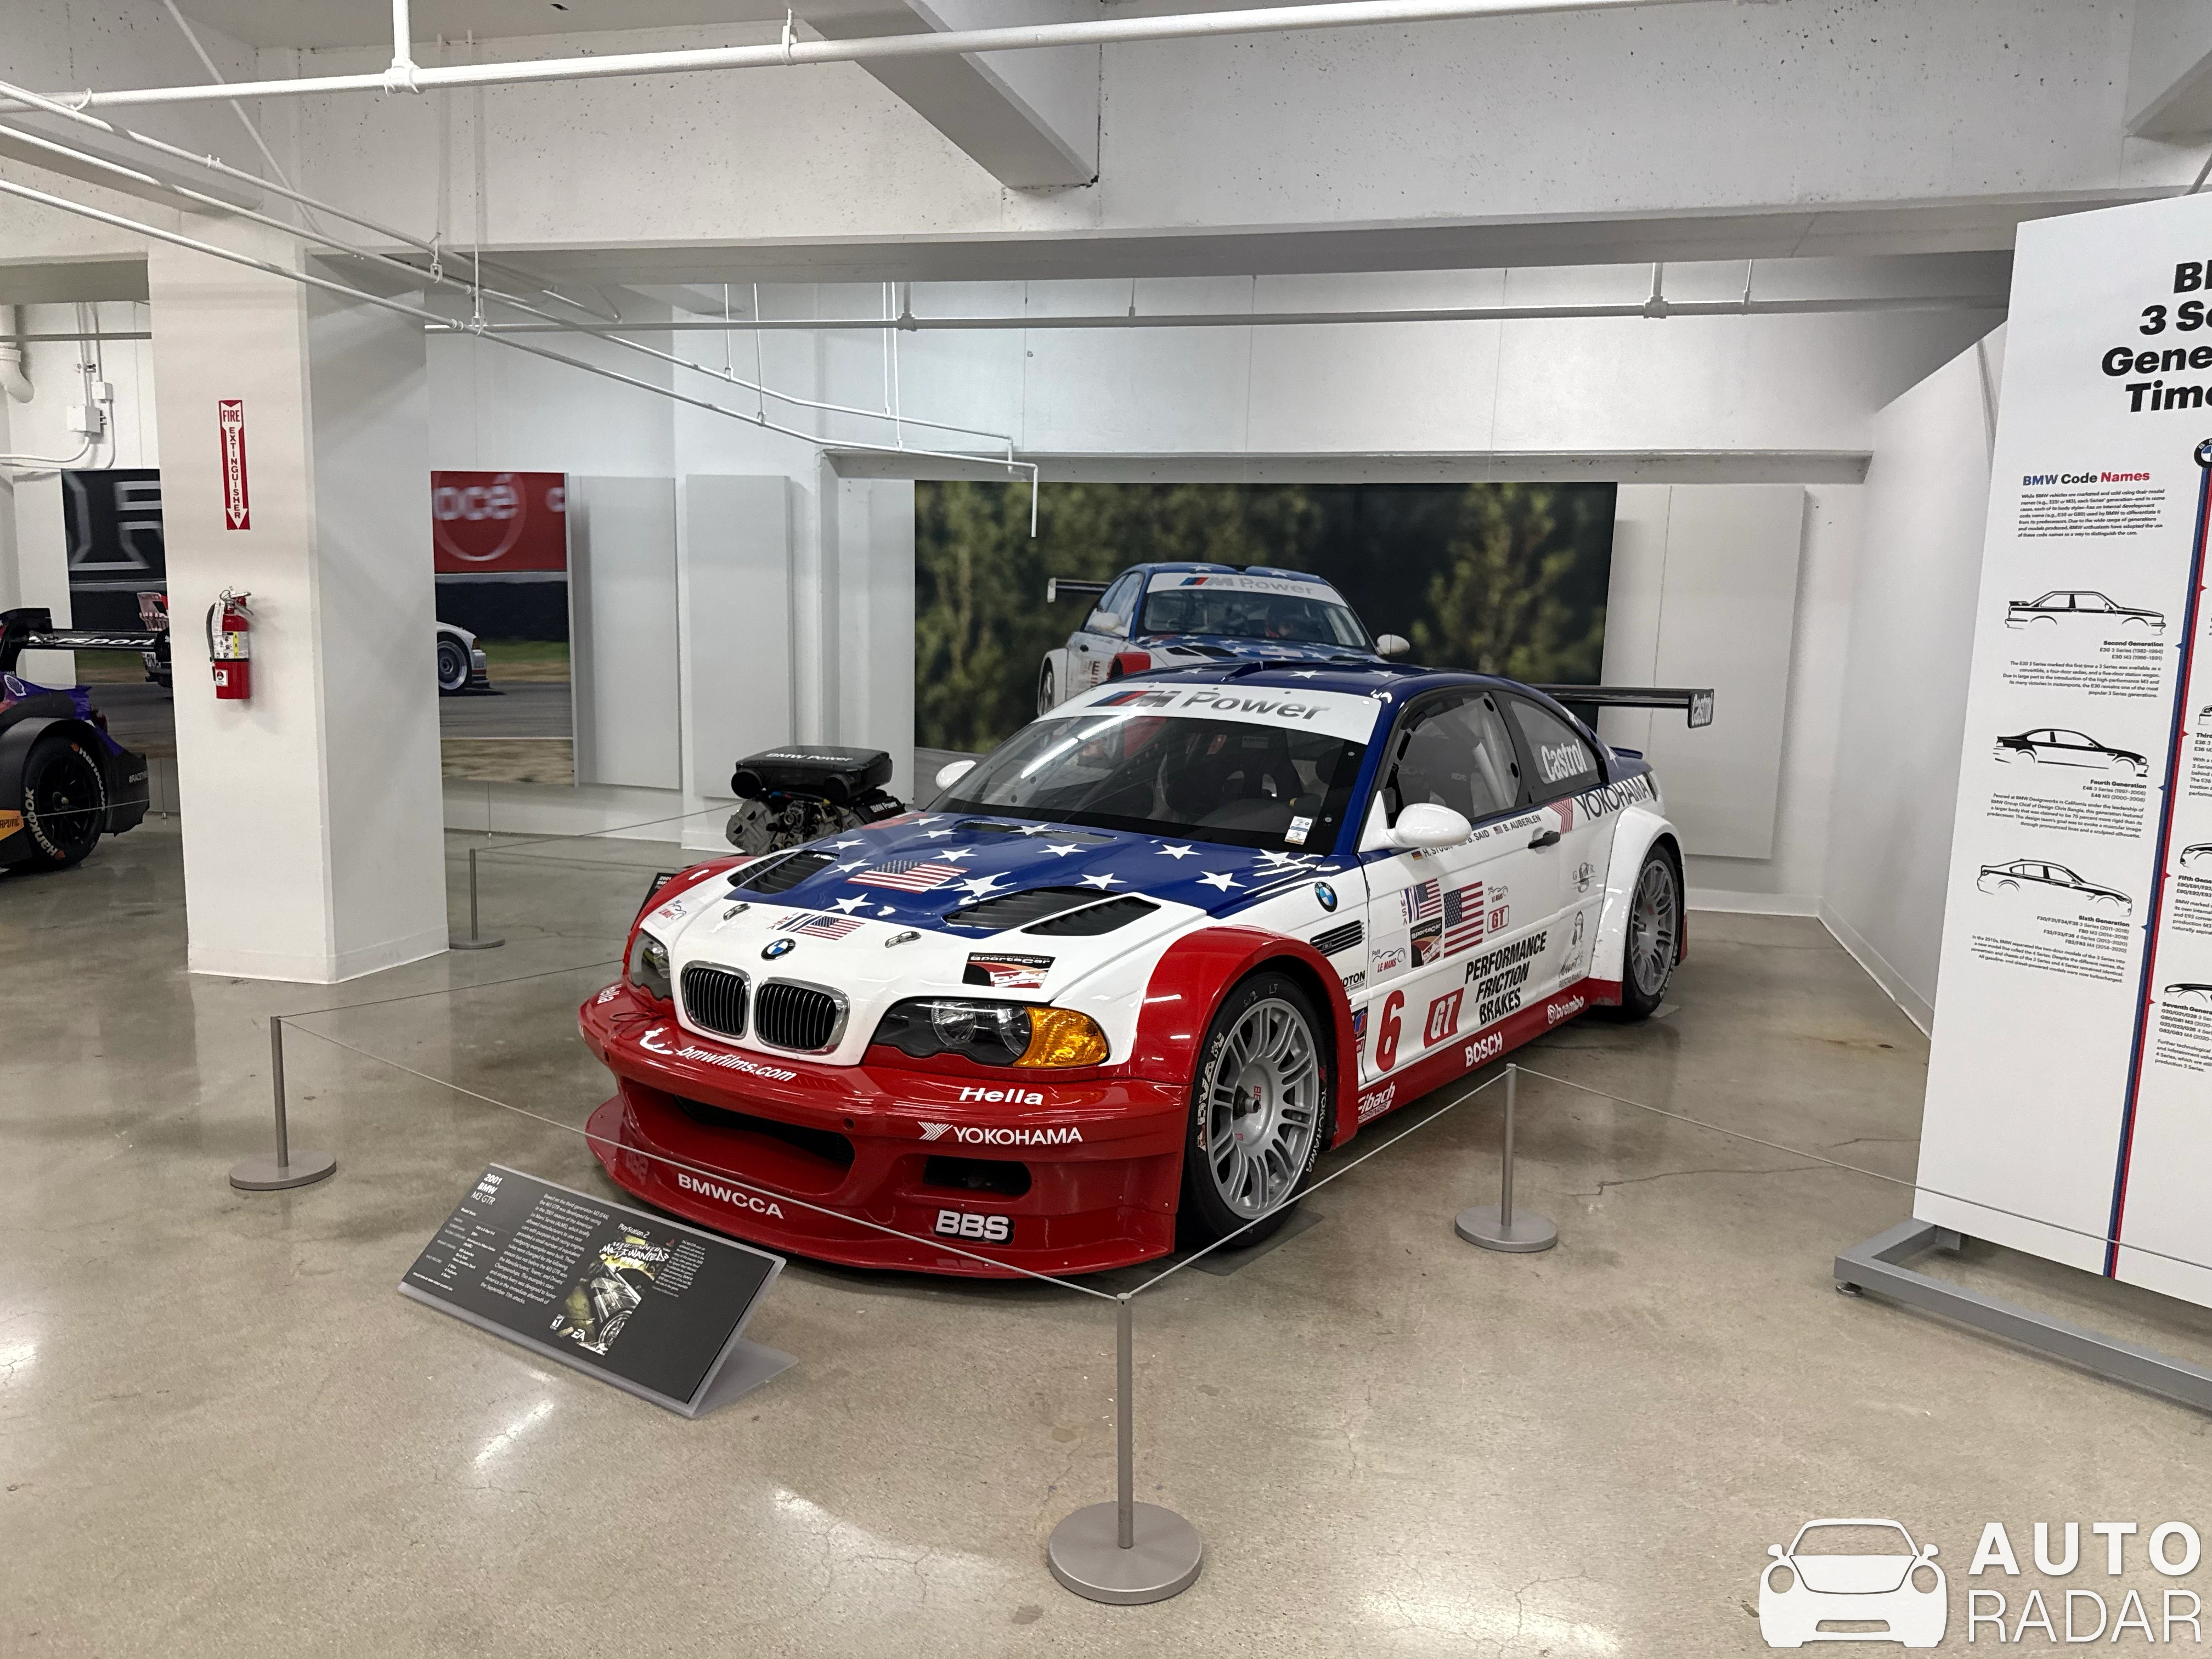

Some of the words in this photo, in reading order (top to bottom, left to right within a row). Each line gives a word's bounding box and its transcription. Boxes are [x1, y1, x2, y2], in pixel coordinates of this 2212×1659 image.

[2140, 305, 2166, 335] 3
[2176, 301, 2212, 331] S
[2102, 346, 2212, 376] Gene
[2125, 380, 2212, 413] Tim
[223, 410, 240, 422] FIRE
[229, 427, 241, 518] EXTINGUISHER
[2023, 475, 2058, 486] BMW
[2061, 473, 2098, 484] Code
[2101, 472, 2150, 482] Names
[1239, 578, 1314, 596] Power
[1180, 691, 1330, 720] Power
[766, 753, 806, 761] BMW
[808, 754, 854, 763] Power
[1541, 738, 1588, 781] Castrol
[1575, 776, 1651, 821] YOKOHAMA
[1511, 814, 1541, 830] AUBERLEN
[1475, 830, 1490, 842] SAID
[1423, 849, 1431, 857] H.
[1492, 909, 1504, 929] GT
[2095, 918, 2130, 927] Generation
[1378, 962, 1384, 973] LE
[1384, 958, 1397, 971] MANS
[1465, 931, 1547, 984] PERFORMANCE
[1340, 970, 1365, 987] OTON
[1475, 962, 1530, 1003] FRICTION
[1480, 988, 1521, 1025] BRAKES
[1554, 995, 1585, 1021] brembo
[2162, 1002, 2188, 1011] Seventh
[1430, 994, 1458, 1040] GT
[1376, 990, 1404, 1073] 6
[1465, 1031, 1503, 1068] BOSCH
[676, 1046, 797, 1082] bmwfilms.com
[960, 1087, 1043, 1105] Hella
[953, 1126, 1082, 1145] YOKOHAMA
[1306, 1088, 1327, 1172] YOKOHAMA
[477, 1182, 498, 1194] BMW
[484, 1173, 503, 1185] 2001
[471, 1191, 482, 1200] M3
[481, 1194, 496, 1206] GTR
[678, 1173, 785, 1220] BMWCCA
[618, 1223, 644, 1237] PlayStation
[935, 1210, 1009, 1240] BBS
[571, 1328, 585, 1341] EA
